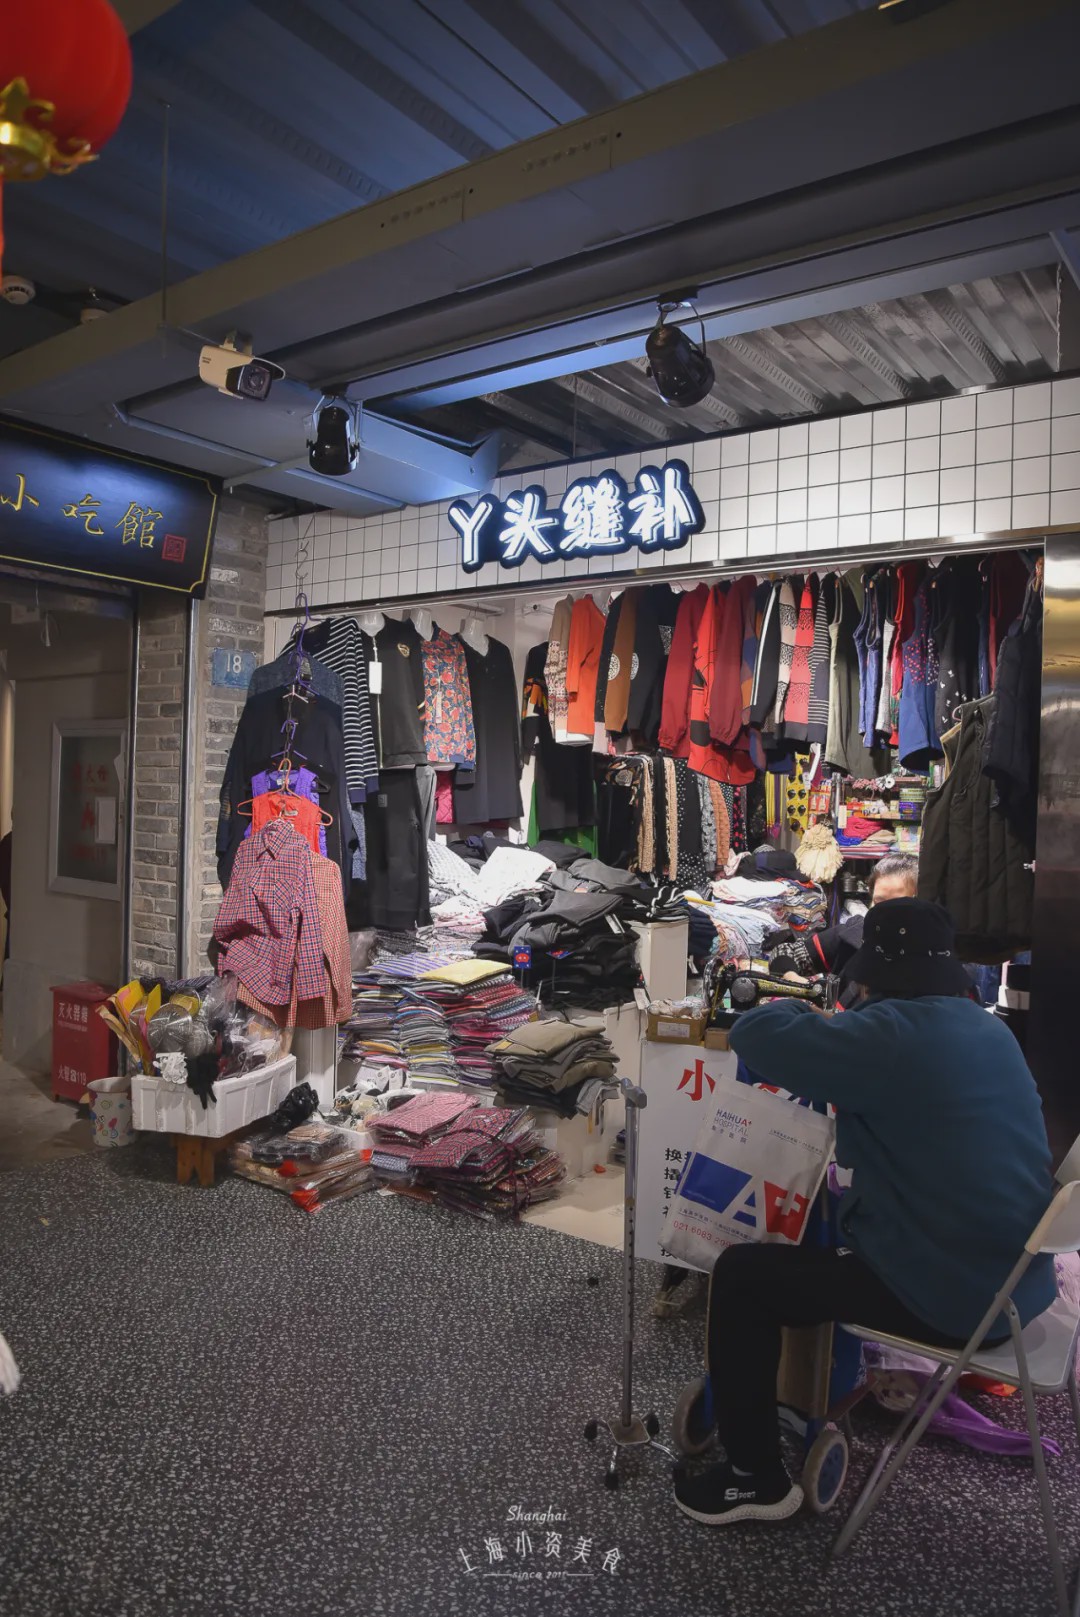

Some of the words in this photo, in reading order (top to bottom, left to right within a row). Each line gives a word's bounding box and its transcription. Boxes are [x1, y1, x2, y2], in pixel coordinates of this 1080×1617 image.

[0, 473, 164, 548] 小吃館
[449, 466, 698, 565] 丫头缝补
[227, 653, 242, 674] 18
